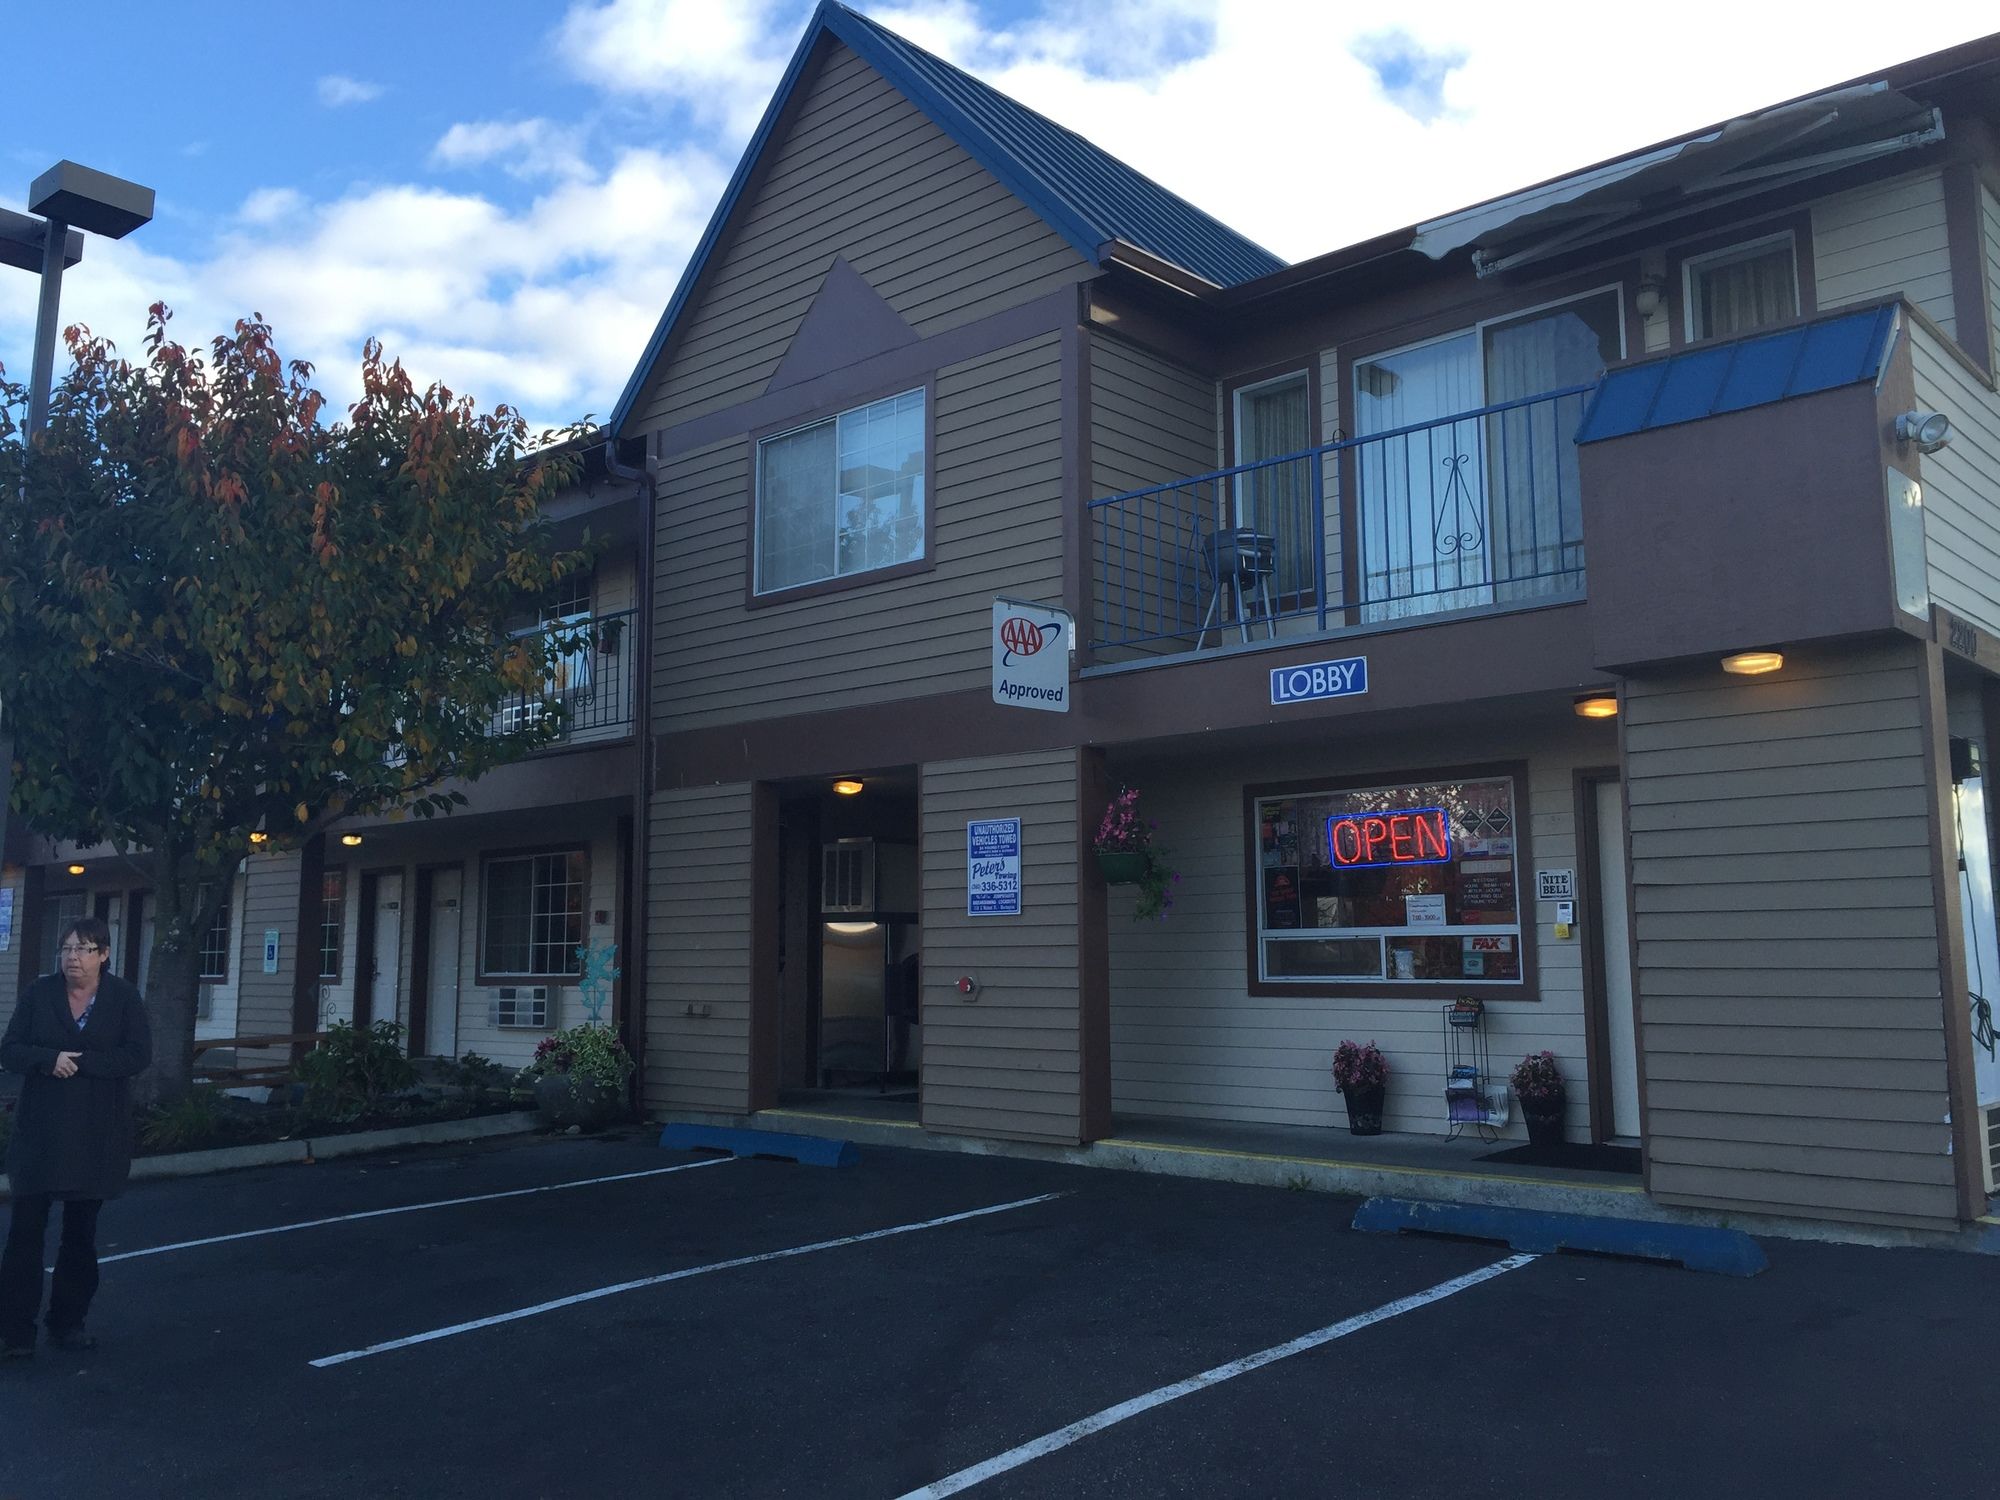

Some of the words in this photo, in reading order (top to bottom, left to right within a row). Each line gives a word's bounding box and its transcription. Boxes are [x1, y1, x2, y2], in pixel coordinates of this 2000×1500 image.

[1003, 618, 1042, 656] AAA
[1279, 663, 1358, 699] LOBBY
[998, 679, 1064, 702] Approved
[973, 823, 1015, 836] UNAUTHORIZED
[972, 834, 998, 846] VEHICLES
[998, 833, 1017, 845] TOWED
[1333, 812, 1447, 863] OPEN
[995, 872, 1018, 881] Towing
[1541, 874, 1569, 884] NITE
[981, 881, 1018, 892] 336-5312
[1543, 885, 1569, 895] BELL
[1472, 937, 1502, 950] FAX
